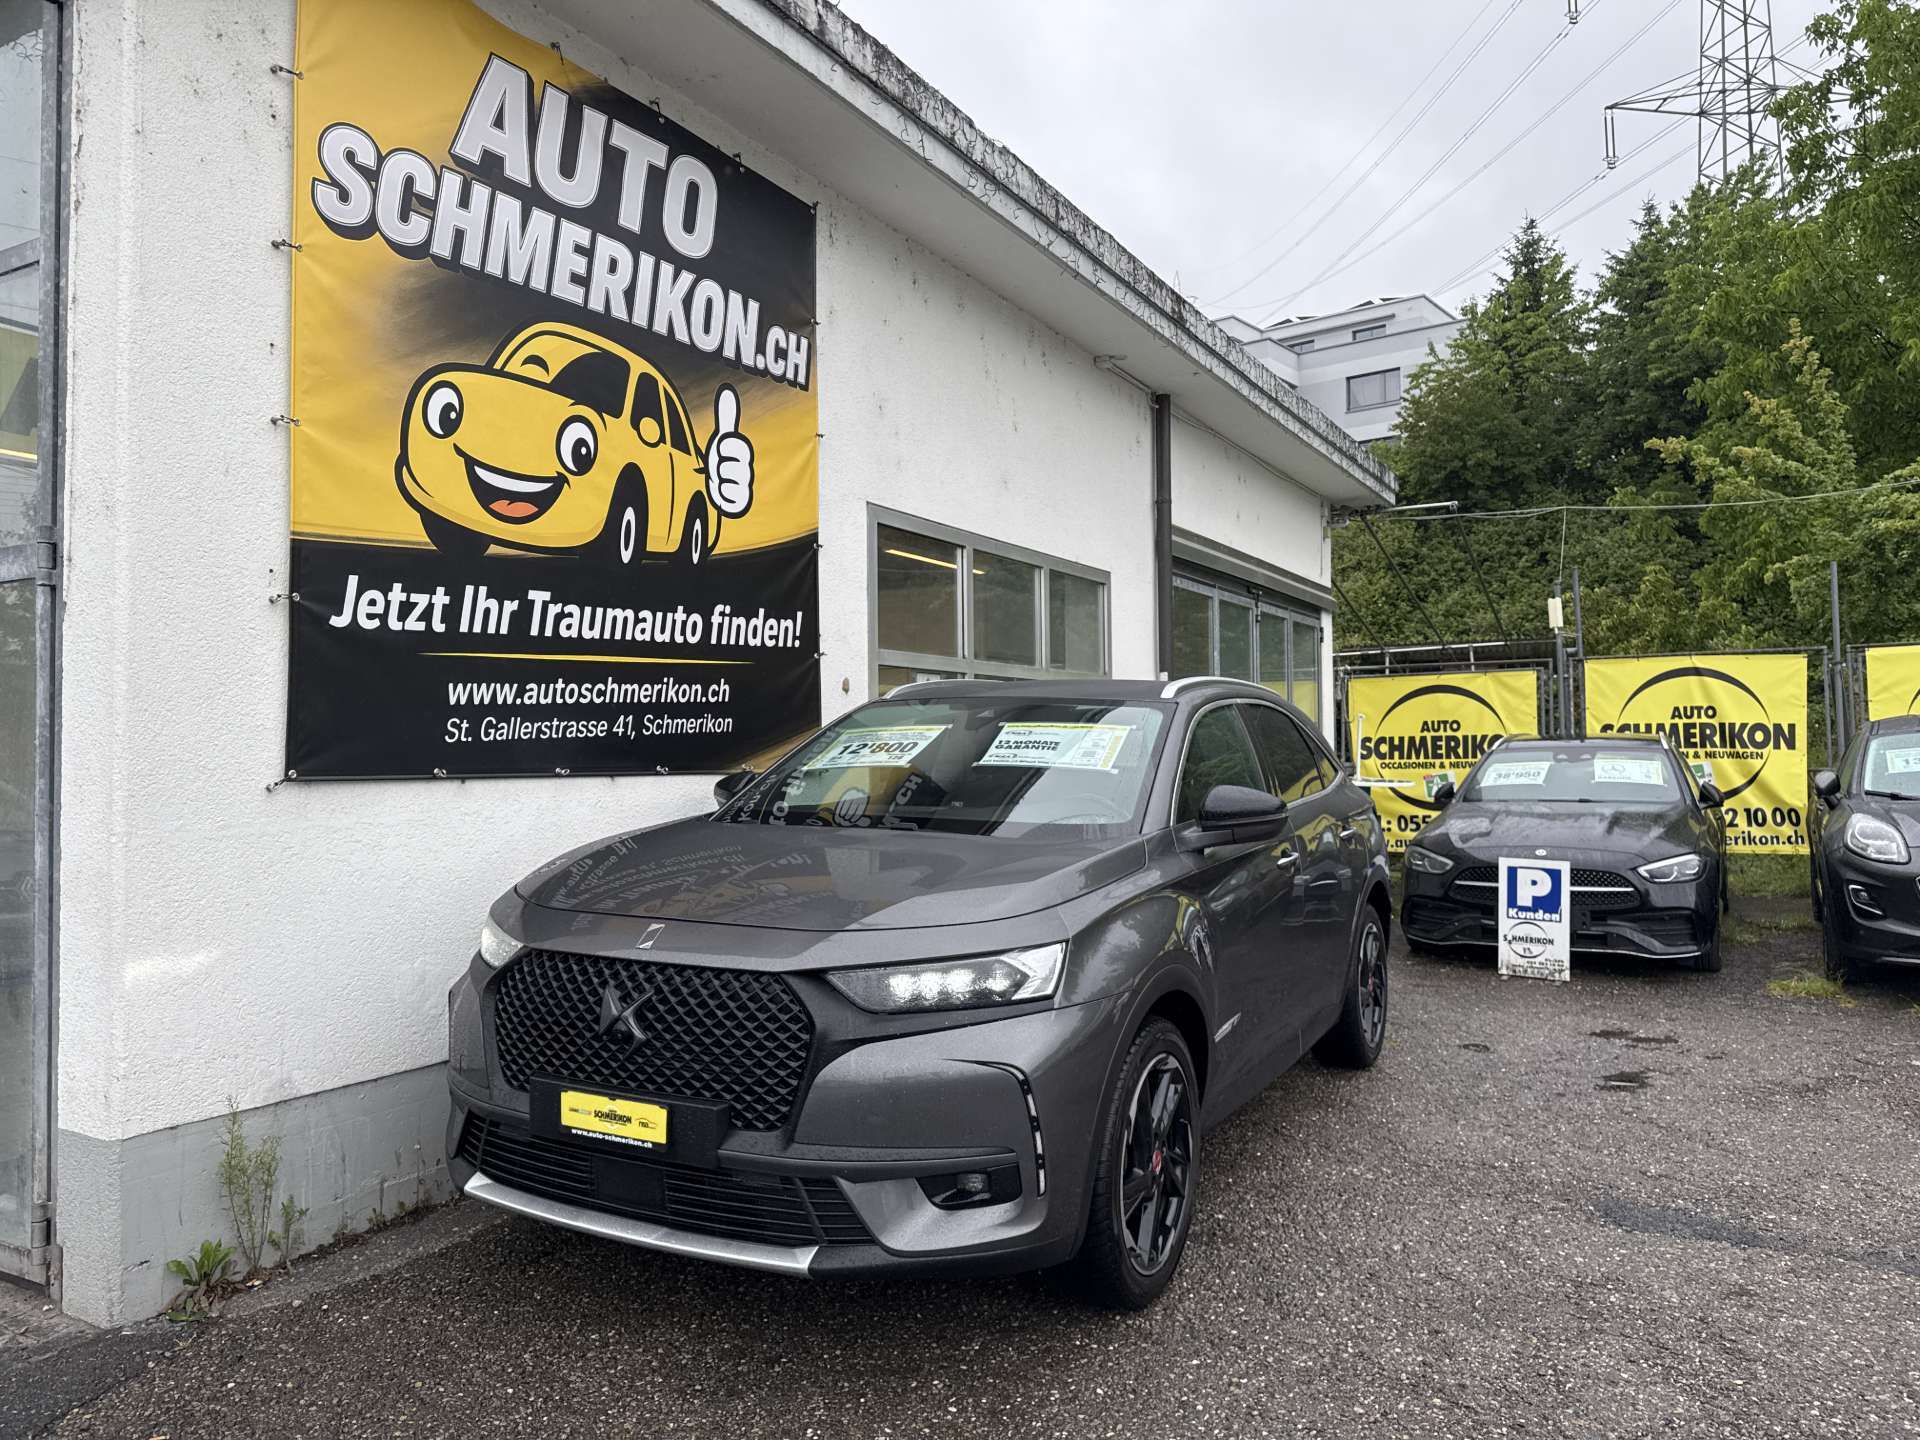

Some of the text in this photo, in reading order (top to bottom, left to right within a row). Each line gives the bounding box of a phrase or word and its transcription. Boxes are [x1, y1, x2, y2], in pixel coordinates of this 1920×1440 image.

[452, 52, 719, 260] AUTO
[312, 124, 809, 387] SCHMERIKON.CH
[329, 575, 803, 648] Jetzt Ihr Traumauto finden!
[448, 677, 730, 705] www.autoschmerikon.ch
[1670, 705, 1717, 720] AUTO
[444, 714, 733, 743] St. Gallerstrasse 41, Schmerikon
[1420, 719, 1461, 733] AUTO
[837, 741, 920, 756] 12'800
[1705, 750, 1764, 760] NEUWAGEN
[1380, 761, 1436, 770] OCCASIONEN
[1771, 806, 1801, 828] 00
[1725, 829, 1805, 846] erikon.ch
[1516, 867, 1552, 908] P
[1508, 907, 1561, 922] Kunden
